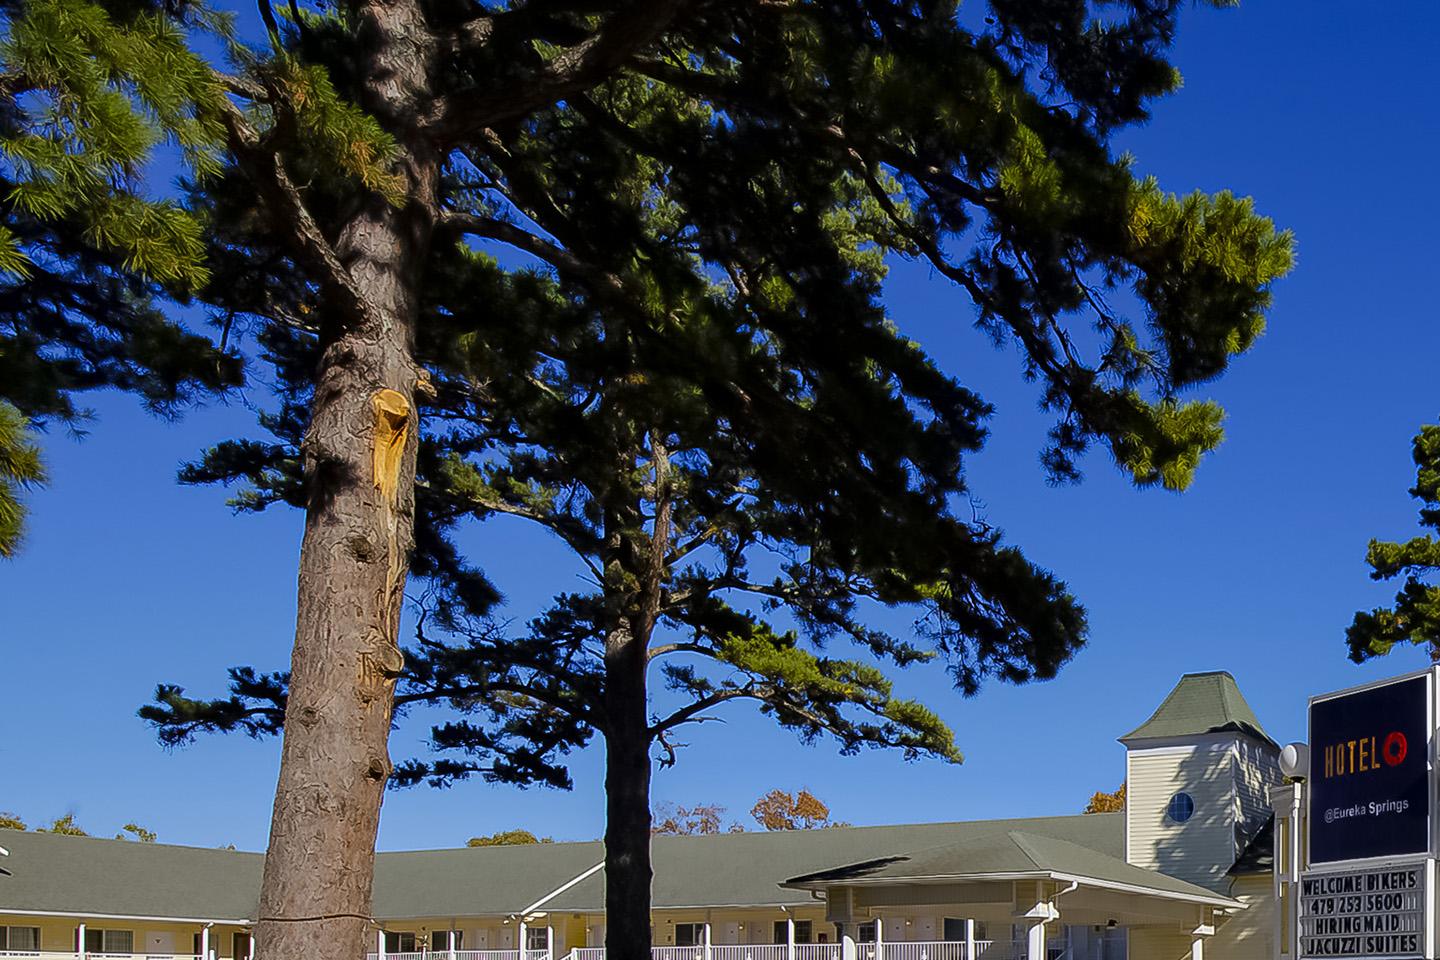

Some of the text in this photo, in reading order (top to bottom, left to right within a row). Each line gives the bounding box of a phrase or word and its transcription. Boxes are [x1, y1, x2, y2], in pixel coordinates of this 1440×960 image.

[1324, 736, 1381, 779] HOTEL
[1324, 799, 1409, 824] @Eureka Springs
[1303, 871, 1417, 896] WELCOME BIKERS
[1311, 893, 1403, 915] 479 253 5600
[1315, 914, 1400, 935] HIRING MAID
[1307, 935, 1417, 955] JACUZZI SUITES
